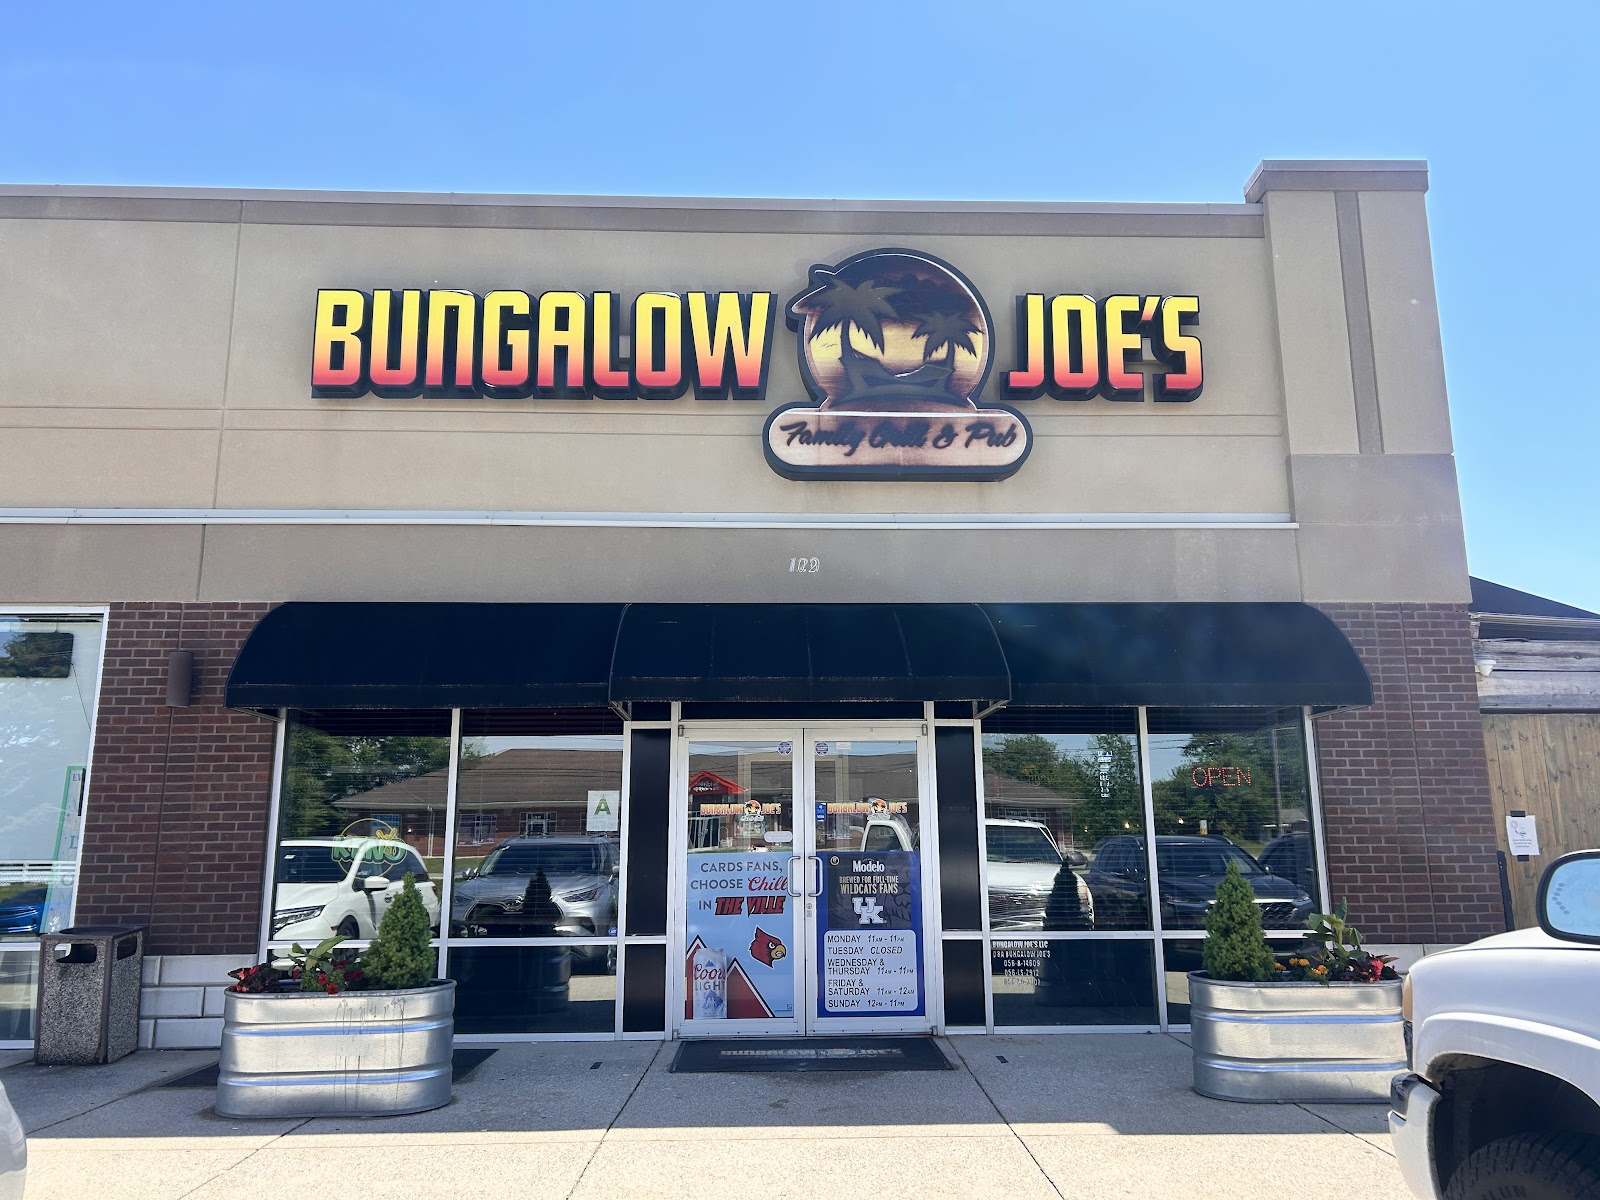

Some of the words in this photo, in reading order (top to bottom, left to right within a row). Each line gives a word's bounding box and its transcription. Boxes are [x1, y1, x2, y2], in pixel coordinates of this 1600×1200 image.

[311, 289, 772, 396] BUNGALOW
[1002, 293, 1204, 397] JOE'S
[780, 421, 866, 456] Family
[964, 421, 1017, 448] Pub
[789, 556, 821, 573] 102
[1192, 766, 1252, 787] OPEN
[594, 798, 611, 816] A
[700, 862, 743, 873] CARDS
[746, 861, 783, 874] FANS,
[852, 860, 885, 872] Modelo
[690, 878, 743, 890] CHOOSE
[747, 875, 788, 891] Chill
[839, 876, 860, 884] BREWED
[861, 876, 872, 884] FOR
[872, 875, 899, 884] FULL-TIME
[840, 883, 877, 894] WILDCATS
[879, 883, 898, 894] FANS
[698, 900, 712, 910] IN
[714, 896, 744, 915] THE
[746, 896, 786, 917] VILLE
[851, 897, 884, 925] UK
[827, 935, 861, 943] MONDAY
[828, 946, 864, 955] TUESDAY
[870, 946, 903, 955] CLOSED
[827, 958, 877, 967] WEDNESDAY
[879, 958, 885, 966] &
[828, 967, 870, 975] THURSDAY
[828, 979, 856, 987] FRIDAY
[858, 978, 864, 987] &
[828, 987, 870, 995] SATURDAY
[828, 999, 861, 1007] SUNDAY
